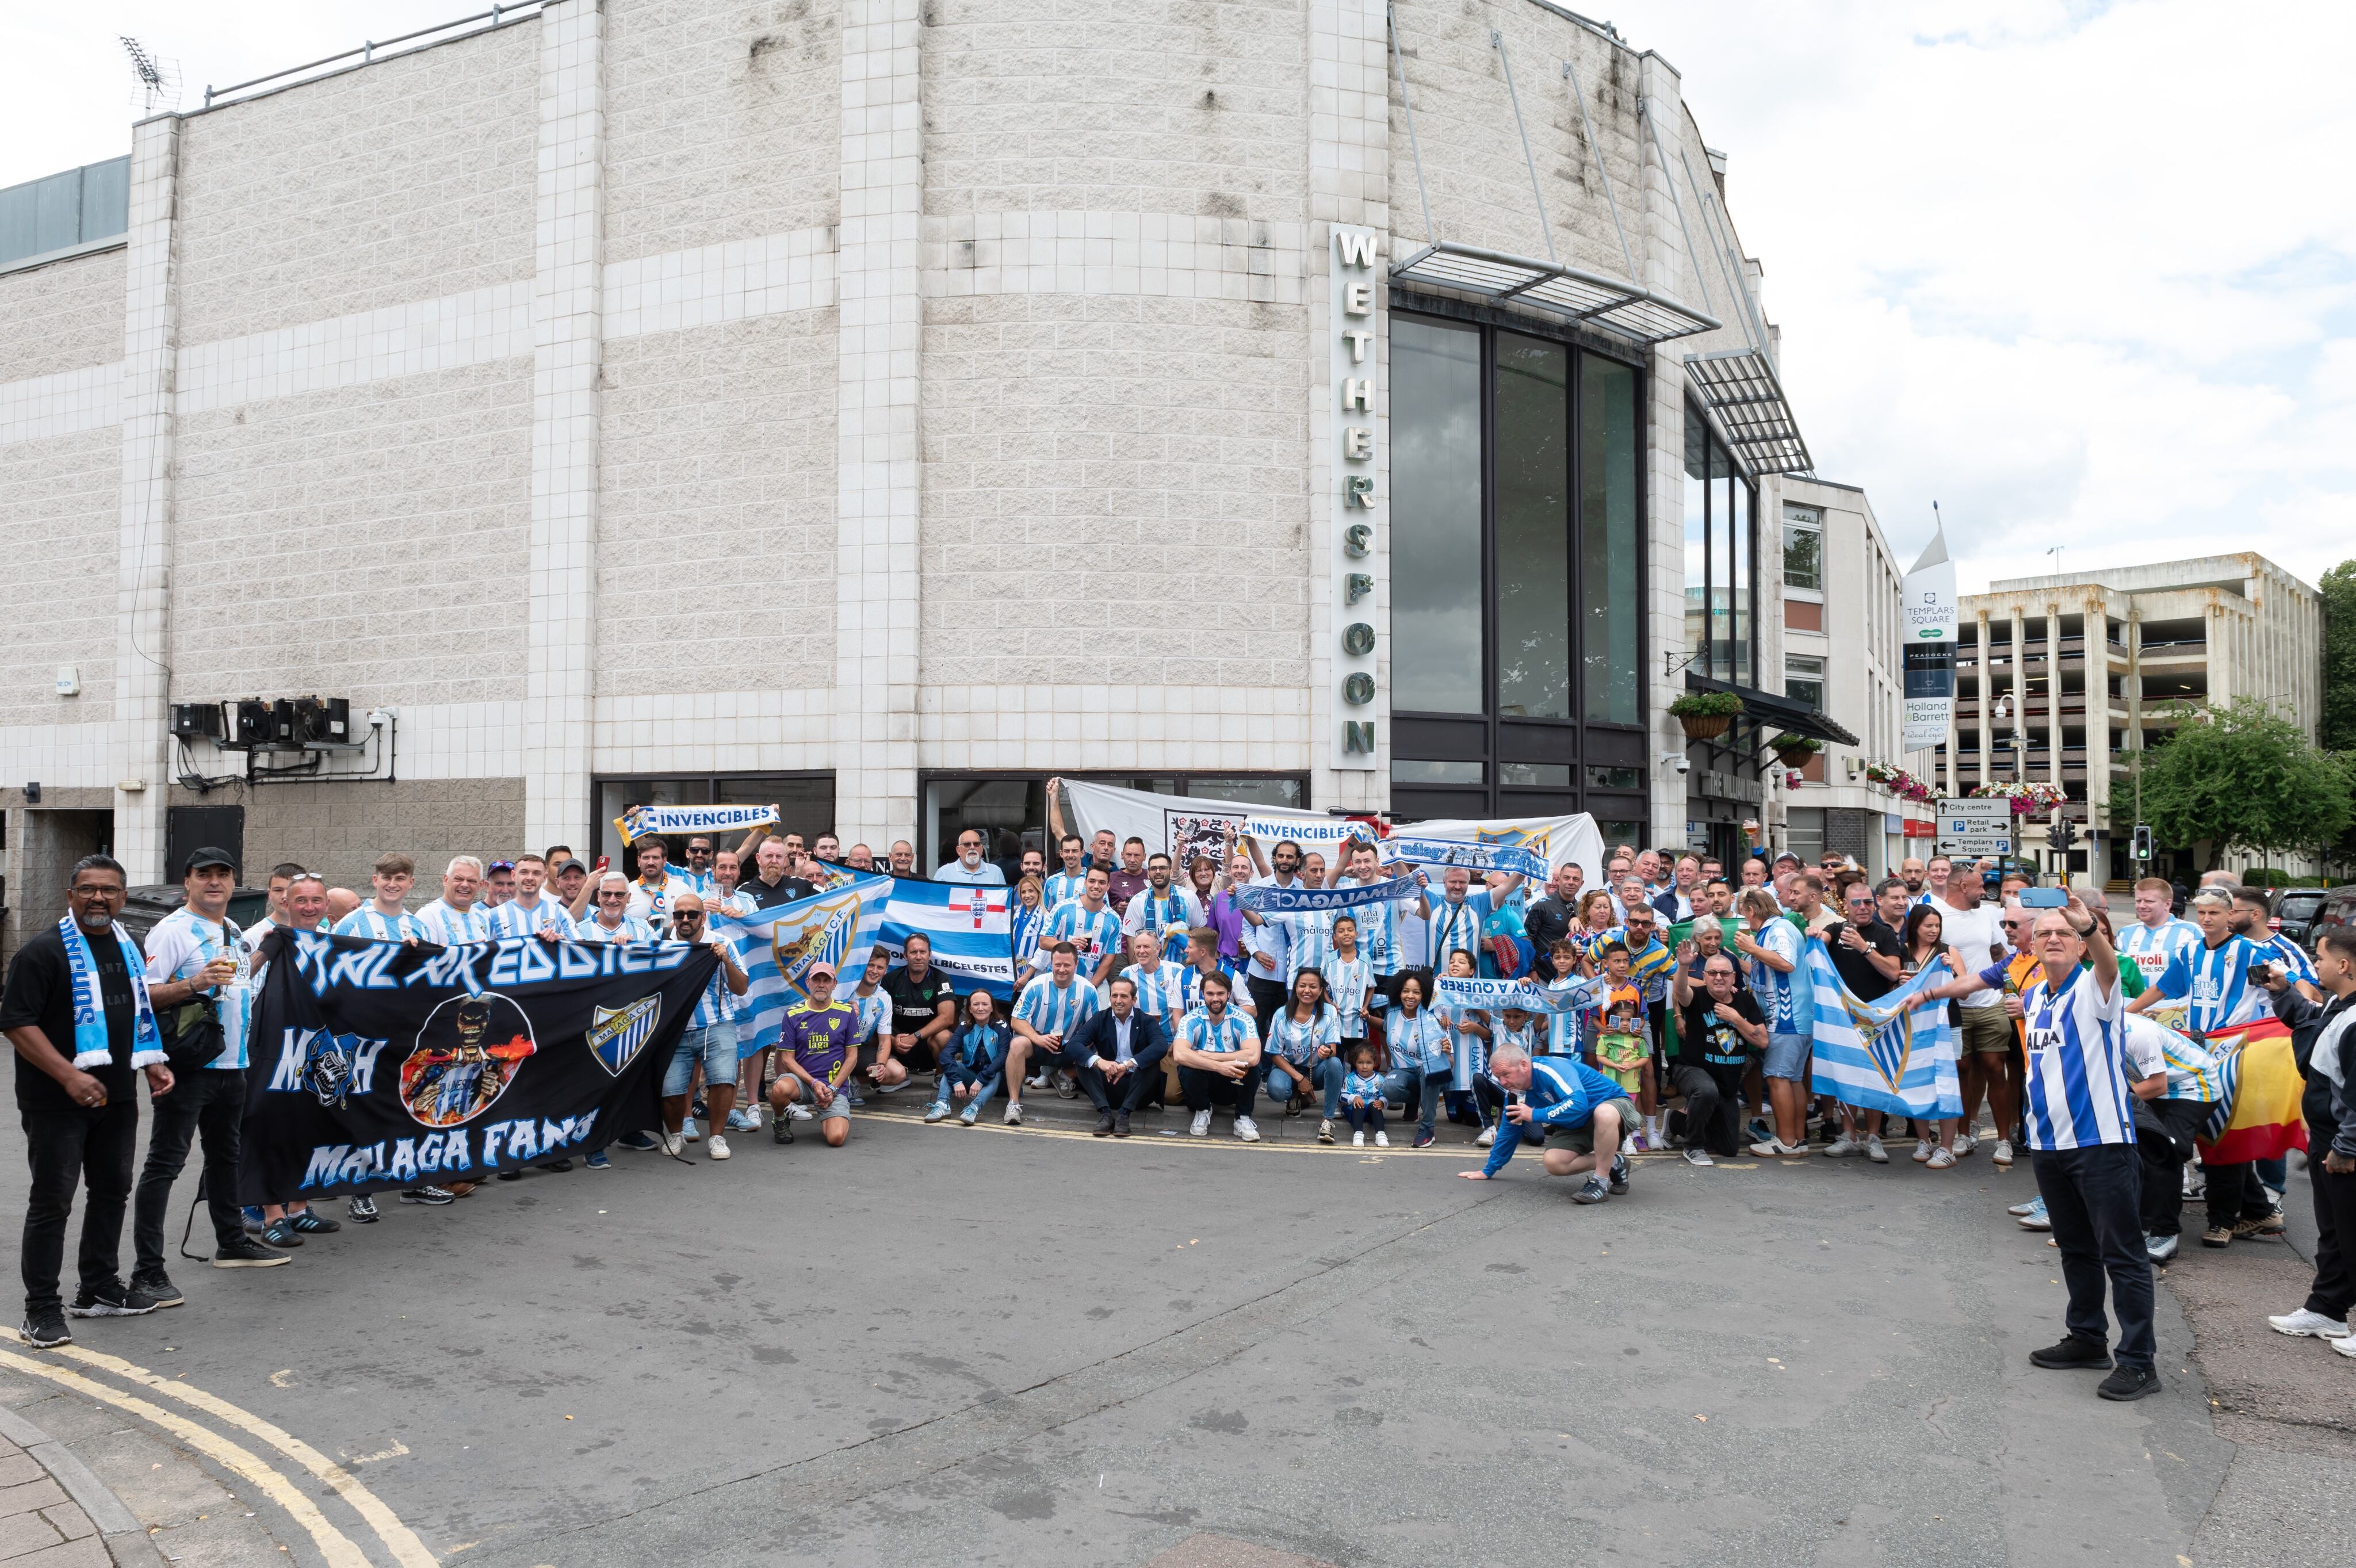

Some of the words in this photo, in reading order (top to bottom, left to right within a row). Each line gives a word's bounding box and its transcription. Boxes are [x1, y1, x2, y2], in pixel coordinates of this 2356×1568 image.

[1335, 232, 1378, 754] WETHERSPOON
[1907, 607, 1954, 615] TEMPLARS
[1911, 615, 1950, 624] SQUARE
[1907, 702, 1946, 711] Holland
[1907, 728, 1927, 739] ideal
[1928, 733, 1945, 741] eyes
[1709, 770, 1722, 797] THE
[1723, 773, 1745, 801] WILLIAM
[1746, 778, 1764, 804] MORRIS
[661, 807, 770, 827] INVENCIBLES
[1251, 822, 1353, 839] INVENCIBLES
[1361, 915, 1379, 925] laga
[791, 931, 832, 974] MALAGA
[830, 910, 846, 928] C.F.
[928, 959, 1008, 974] ALBICELESTES
[1440, 980, 1494, 994] QUERER
[1498, 983, 1508, 994] A
[1471, 995, 1494, 1007] NO
[1498, 995, 1542, 1009] COMO
[598, 1013, 636, 1041] MALAGA
[637, 1001, 652, 1015] C.F.
[1566, 1020, 1574, 1038] UAX
[808, 1041, 829, 1050] laga
[2215, 1043, 2232, 1061] C.F.
[1471, 1046, 1481, 1070] UAX
[299, 1128, 472, 1190] MALAGA
